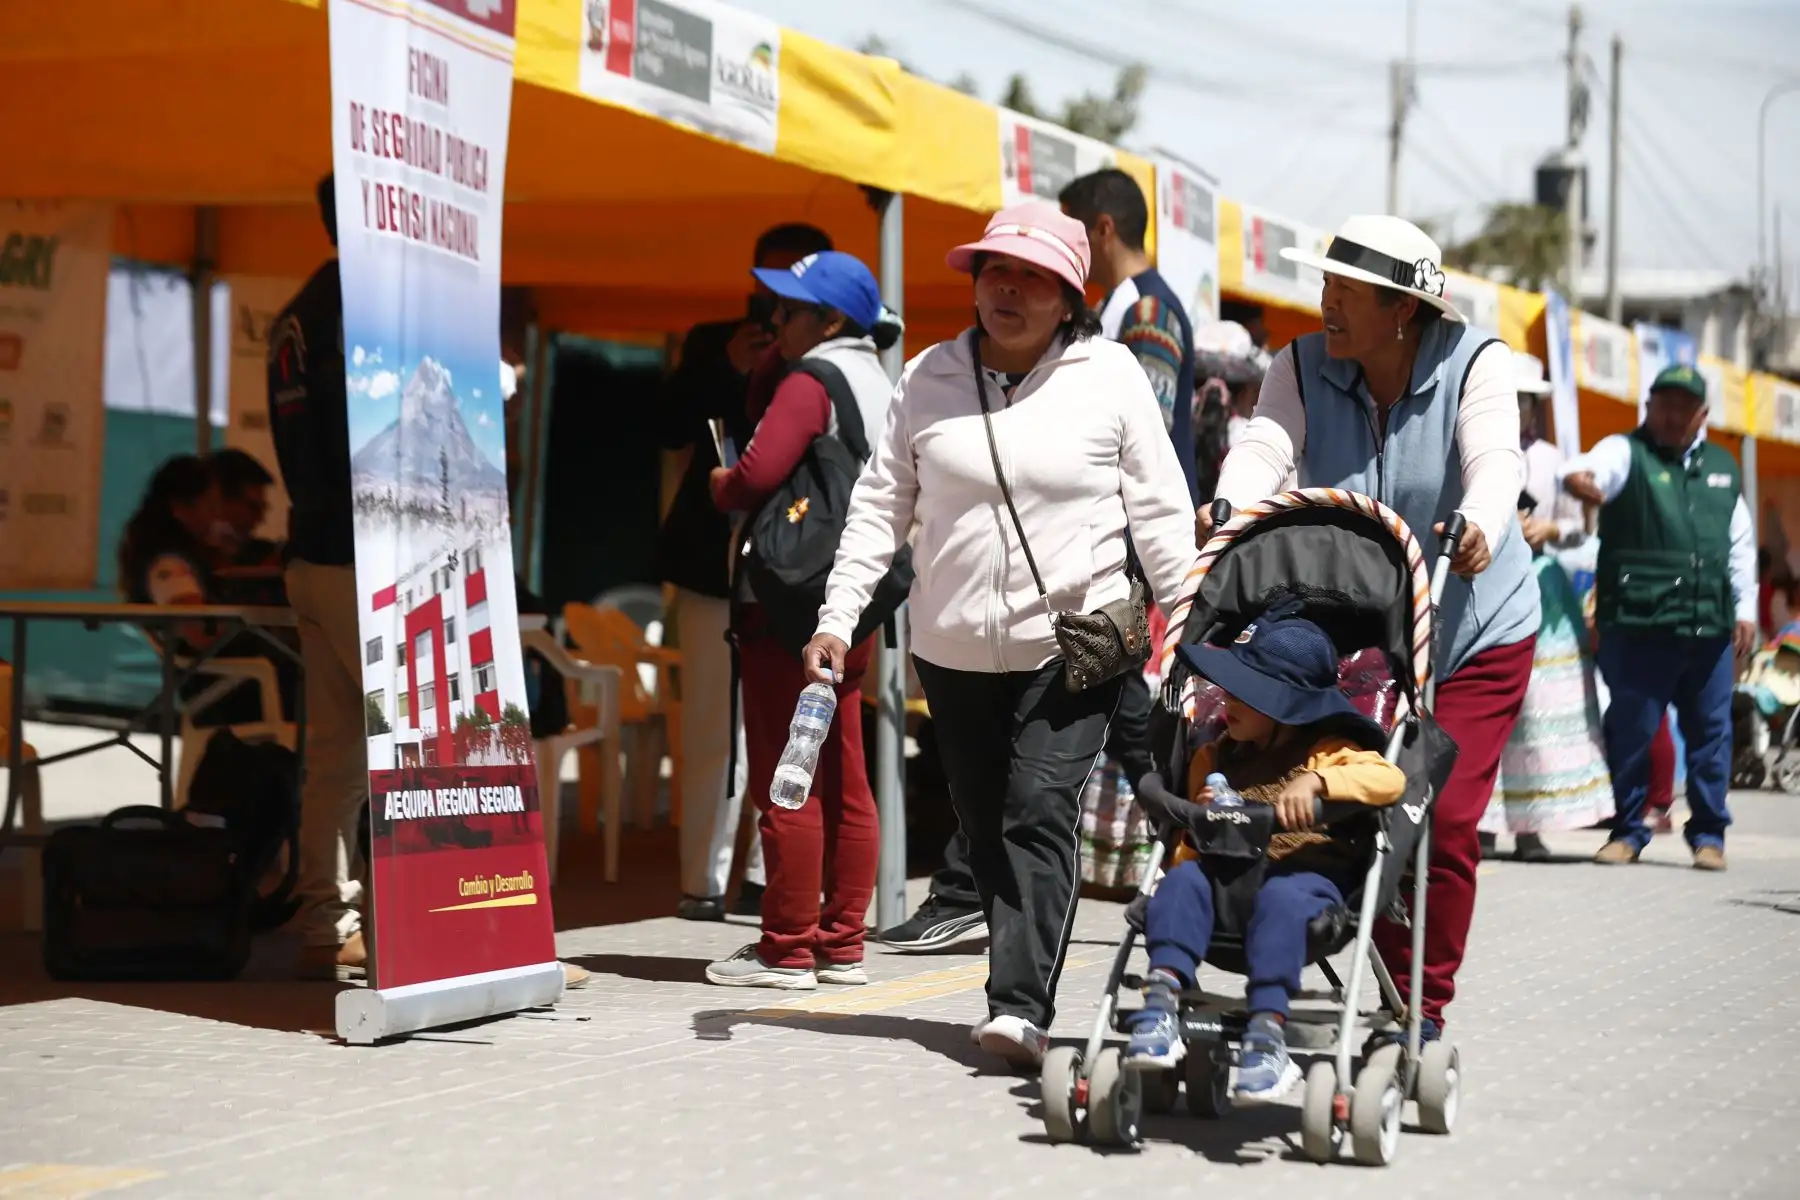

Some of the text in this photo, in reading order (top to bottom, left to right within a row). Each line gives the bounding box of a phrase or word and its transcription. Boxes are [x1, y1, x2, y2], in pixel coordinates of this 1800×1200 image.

[350, 100, 367, 152] DE
[361, 178, 370, 229] Y
[435, 781, 479, 816] REGIÓN
[479, 786, 525, 814] SEGURA
[459, 870, 533, 898] Cambio y Desarrollo
